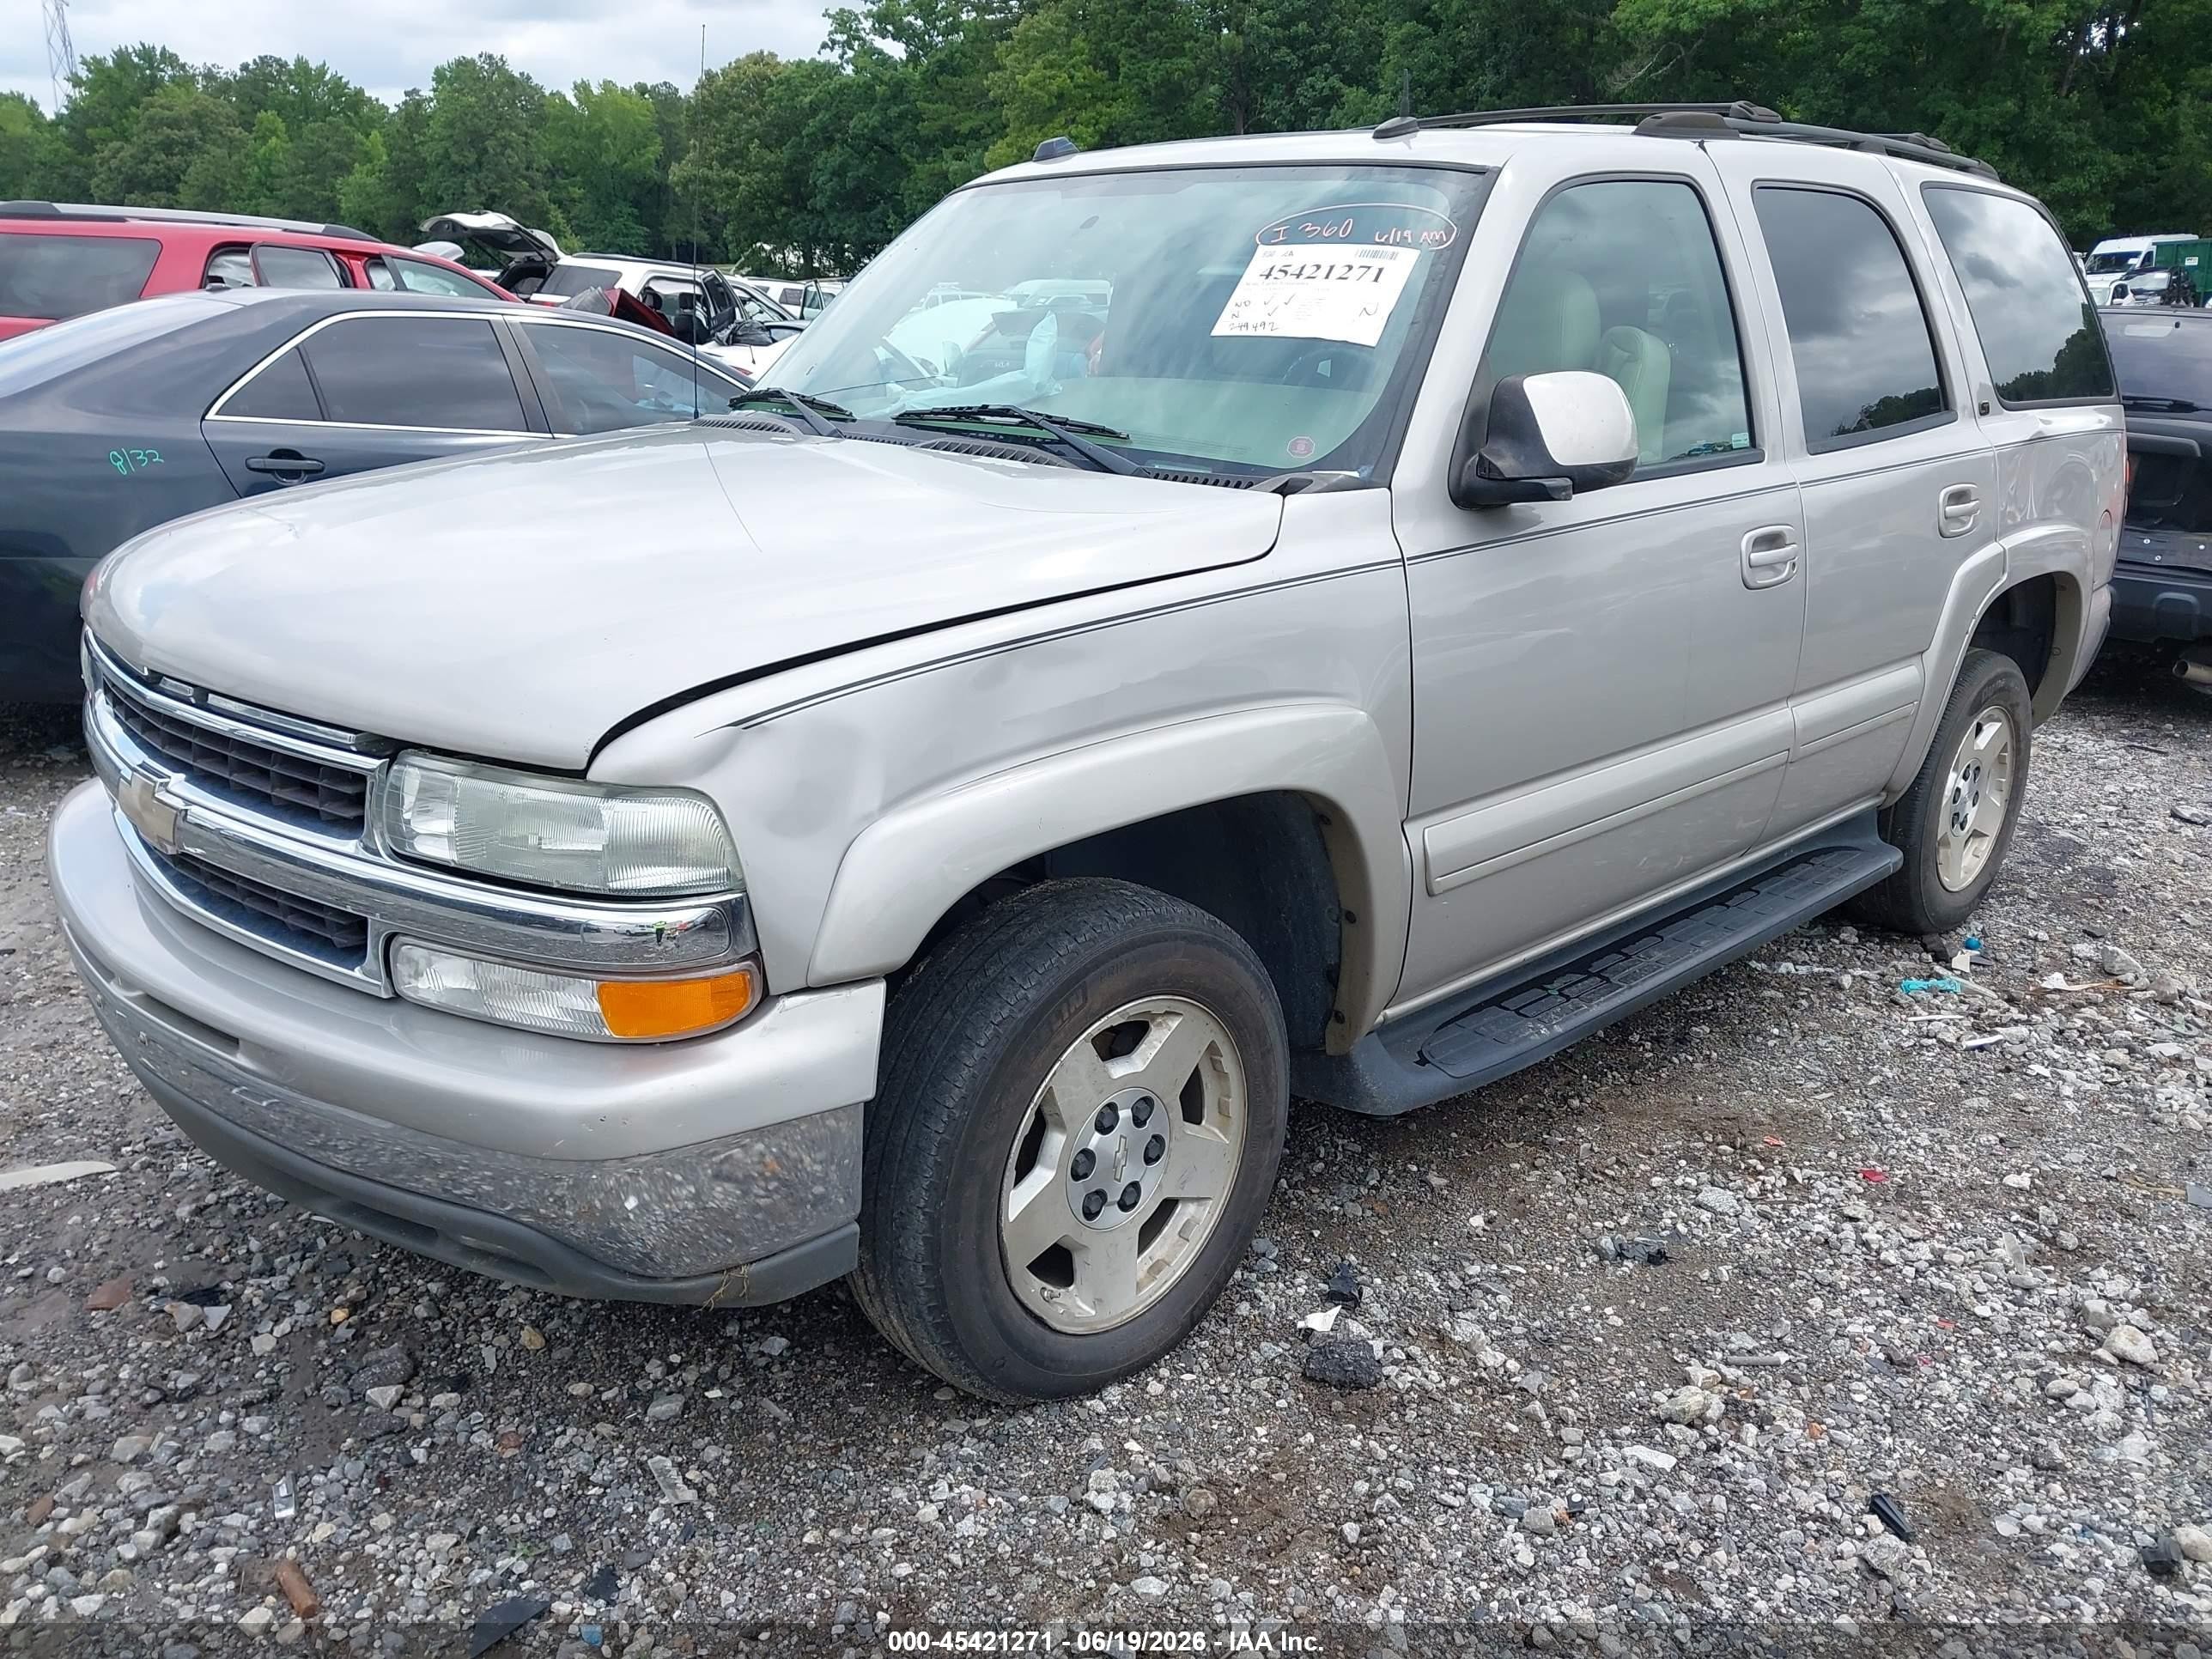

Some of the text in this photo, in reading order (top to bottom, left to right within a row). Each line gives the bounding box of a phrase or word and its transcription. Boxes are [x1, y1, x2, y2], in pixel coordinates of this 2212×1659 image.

[1297, 218, 1354, 239] 360
[1419, 230, 1447, 245] AM
[1259, 264, 1385, 283] 45421271
